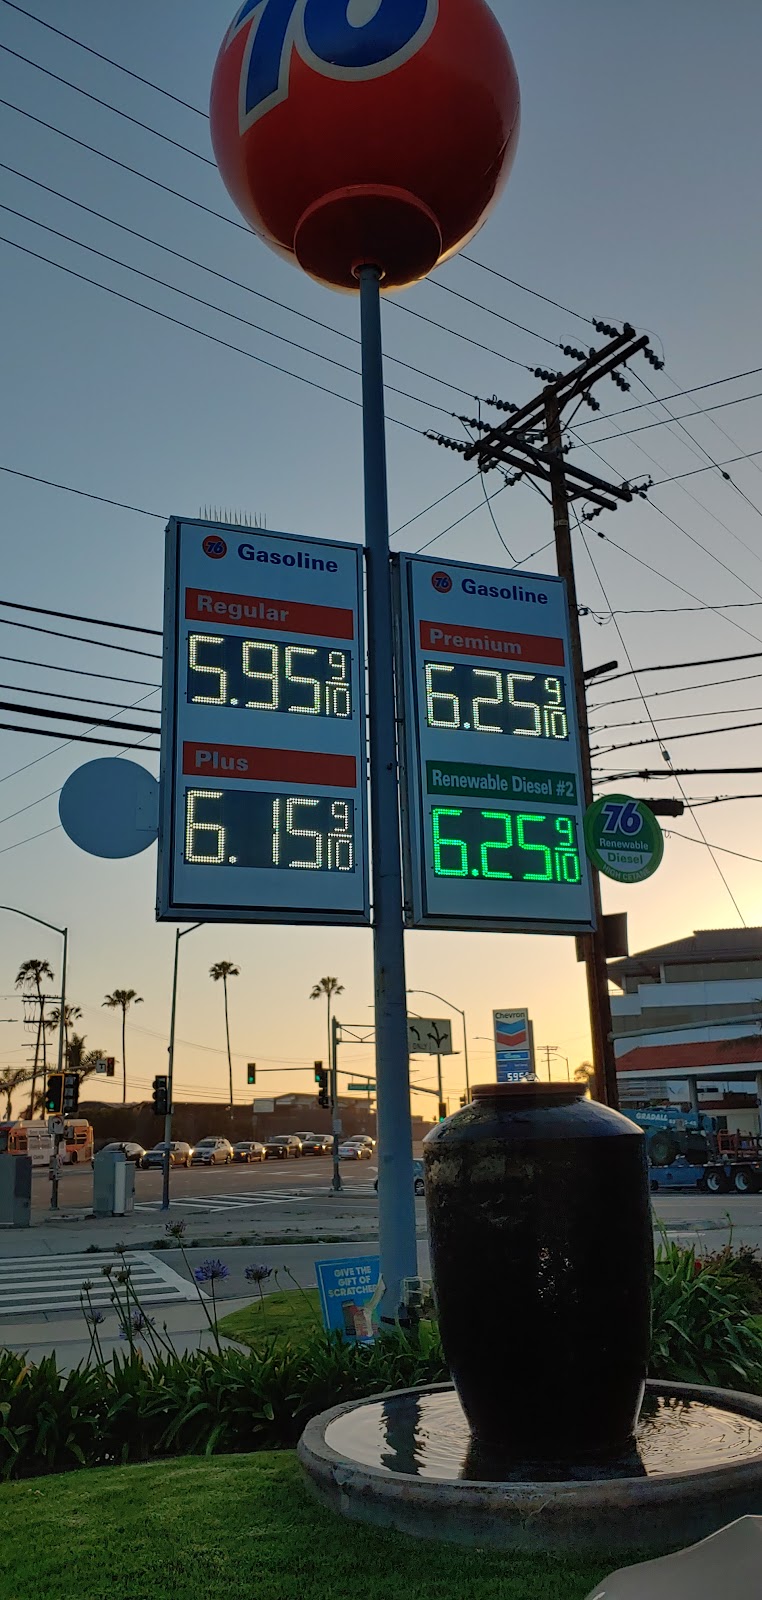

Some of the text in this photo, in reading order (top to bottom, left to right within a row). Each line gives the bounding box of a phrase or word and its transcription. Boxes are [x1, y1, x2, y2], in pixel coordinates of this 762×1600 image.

[204, 540, 338, 572] 76 Gasoline
[433, 576, 549, 605] 76 Gasoline
[197, 594, 289, 621] Regular
[429, 628, 522, 655] Premium
[189, 634, 320, 714] 5.95
[425, 663, 542, 737] 6.25
[195, 749, 249, 771] Plus
[432, 768, 575, 797] Renewable Diesel #2
[185, 789, 322, 869] 6.15
[600, 799, 644, 837] 76
[433, 808, 553, 881] 6.25
[599, 837, 649, 850] Renewable
[602, 863, 621, 880] HIGH
[608, 852, 643, 865] Diesel
[495, 1012, 526, 1020] Chevron
[635, 1112, 669, 1121] GRADALL
[334, 1266, 371, 1277] GIVE THE
[339, 1276, 370, 1287] GIFT OF
